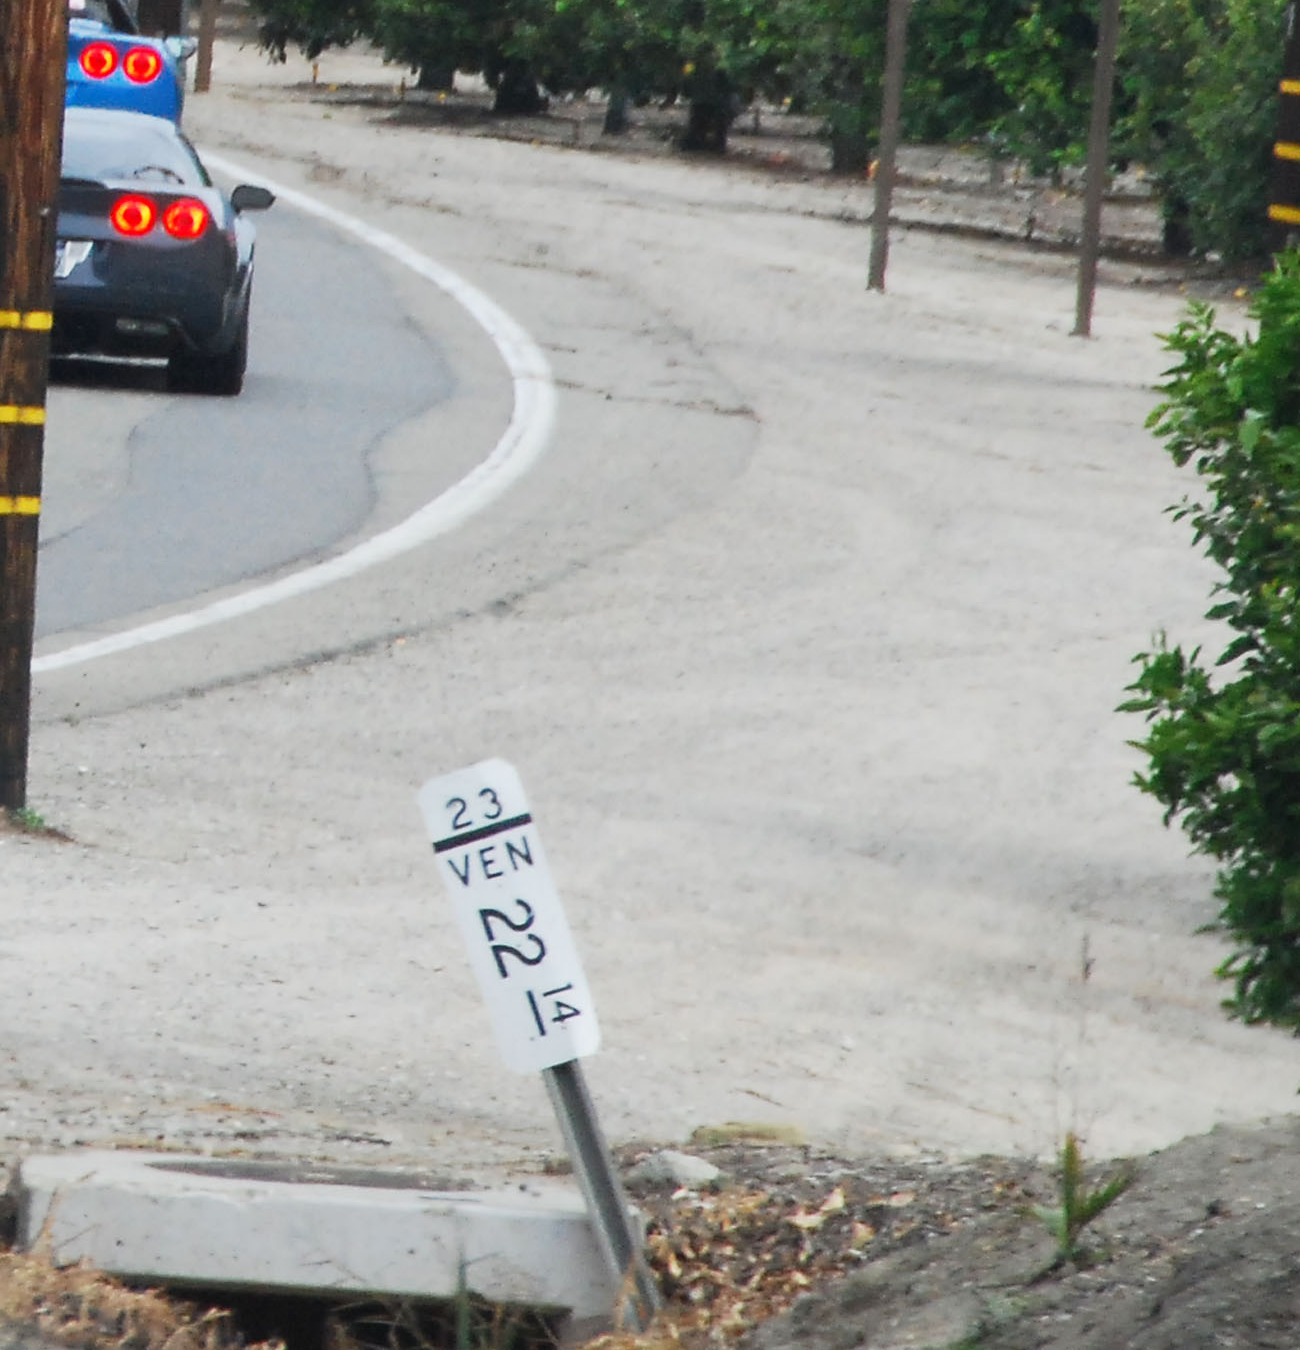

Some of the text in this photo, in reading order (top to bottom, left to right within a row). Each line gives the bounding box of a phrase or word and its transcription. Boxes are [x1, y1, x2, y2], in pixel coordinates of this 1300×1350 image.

[445, 787, 503, 830] 23
[448, 835, 534, 886] VEN
[478, 898, 547, 979] 22
